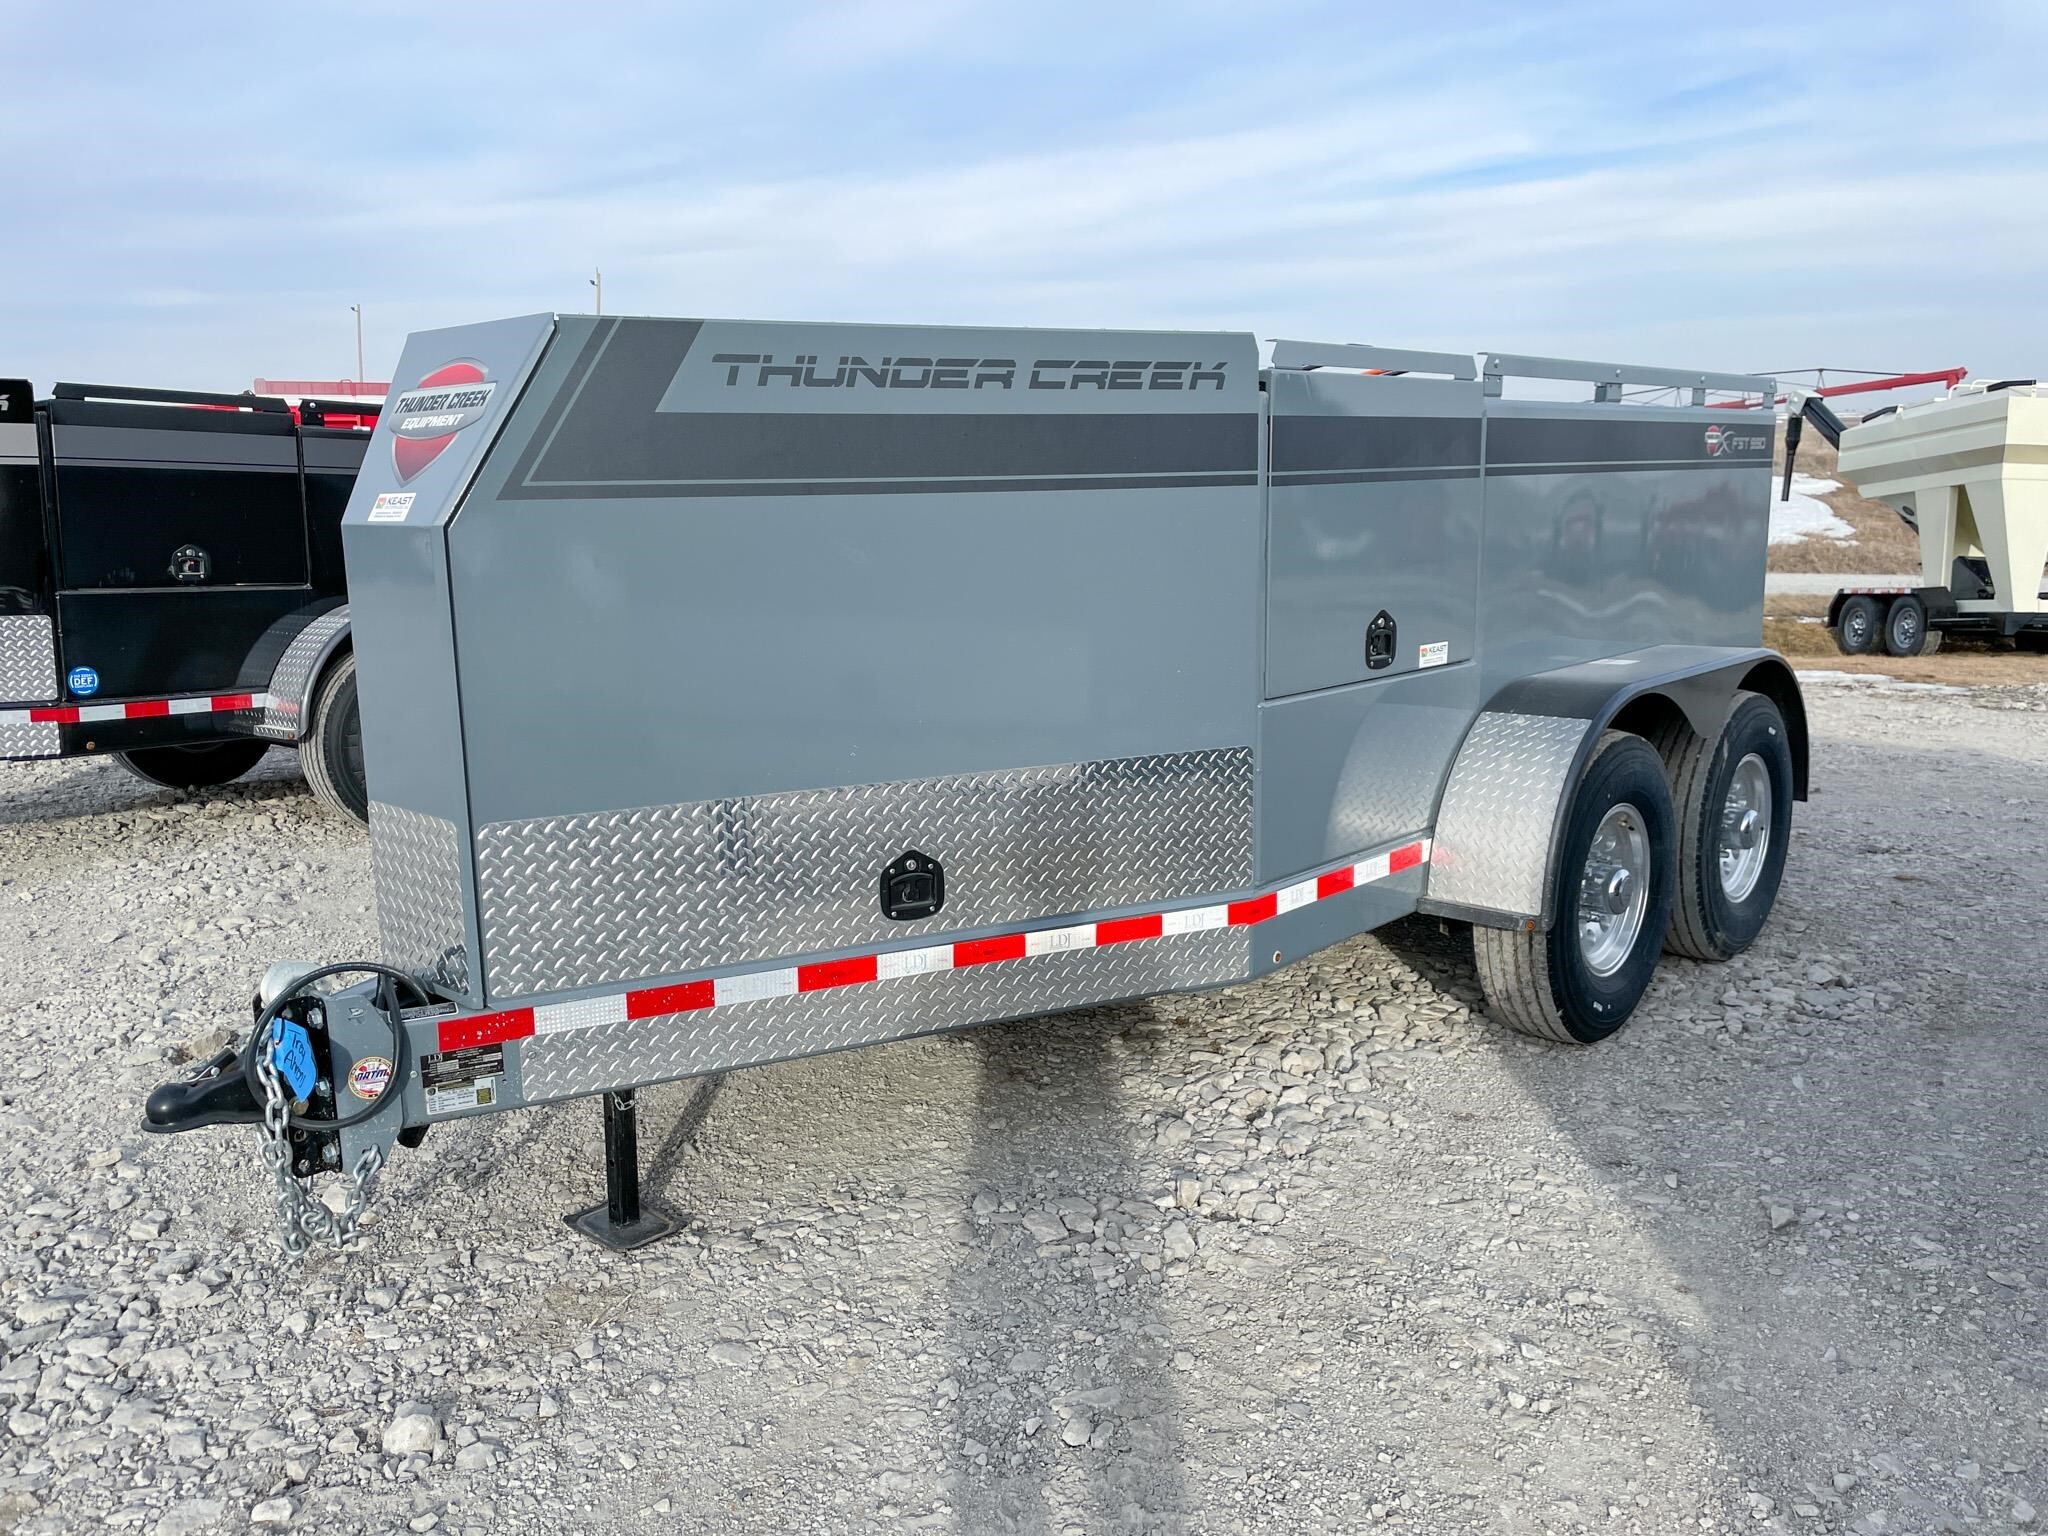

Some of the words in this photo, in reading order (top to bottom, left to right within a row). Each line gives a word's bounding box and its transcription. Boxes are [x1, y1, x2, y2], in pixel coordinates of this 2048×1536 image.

[712, 353, 1016, 389] THUNDER
[1029, 359, 1228, 391] CREEK
[395, 393, 451, 414] THUNDER
[446, 390, 492, 409] CREEK
[401, 414, 464, 430] EQUIPMENT
[386, 496, 415, 505] KEAST
[1429, 644, 1447, 653] KEAST
[74, 677, 93, 685] DEF
